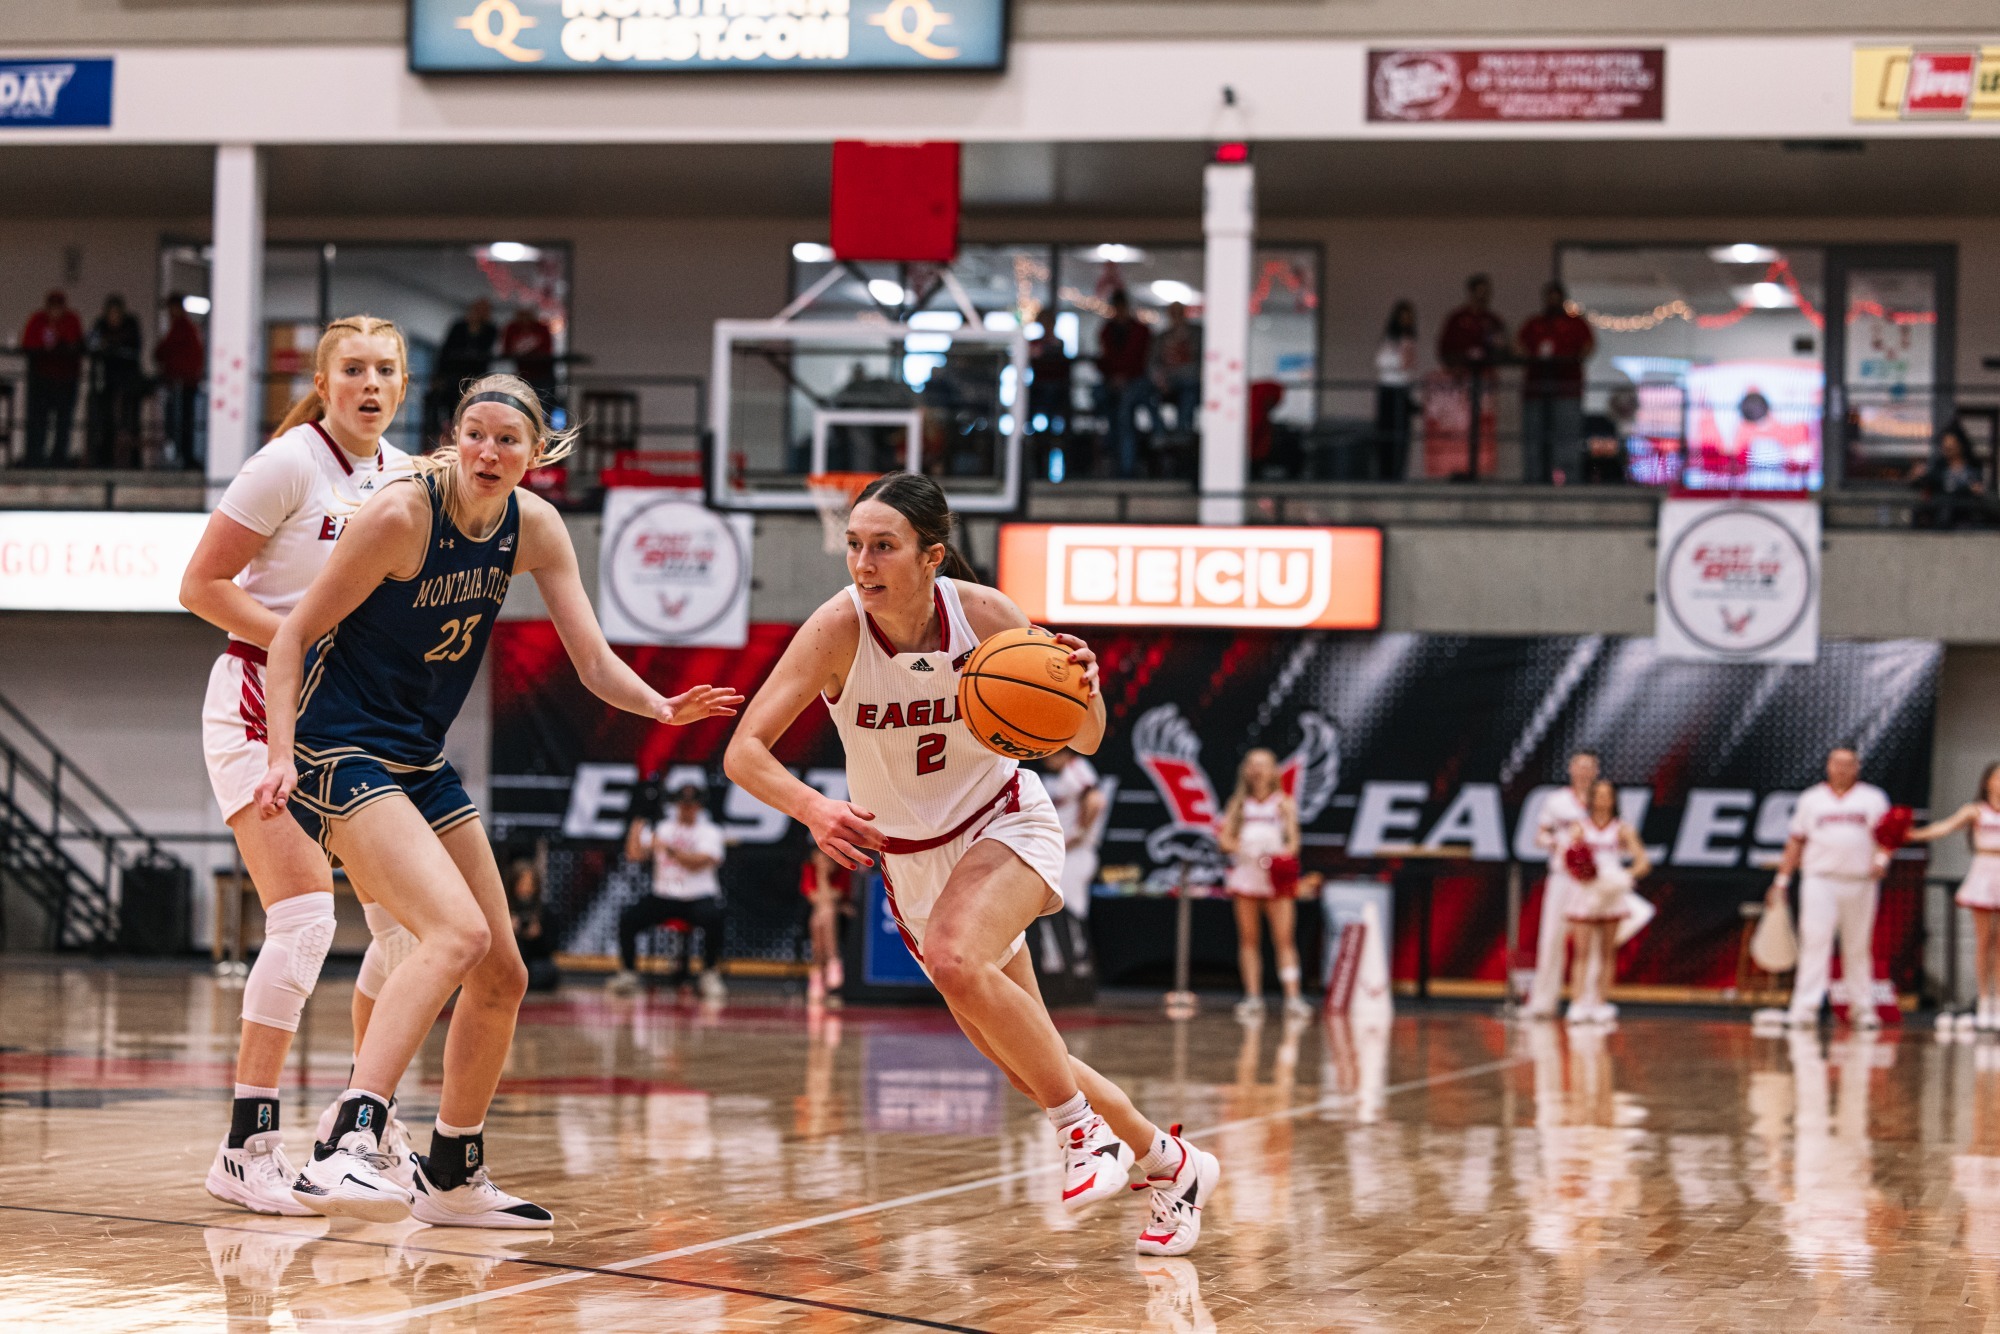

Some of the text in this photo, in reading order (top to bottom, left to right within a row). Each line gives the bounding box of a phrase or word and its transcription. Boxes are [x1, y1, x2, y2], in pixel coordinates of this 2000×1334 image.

[561, 17, 849, 61] QUEST.COM
[1, 540, 50, 576] GO
[1071, 548, 1309, 606] BECU
[412, 567, 482, 608] MONTANA
[424, 613, 482, 662] 23
[916, 733, 946, 776] 2
